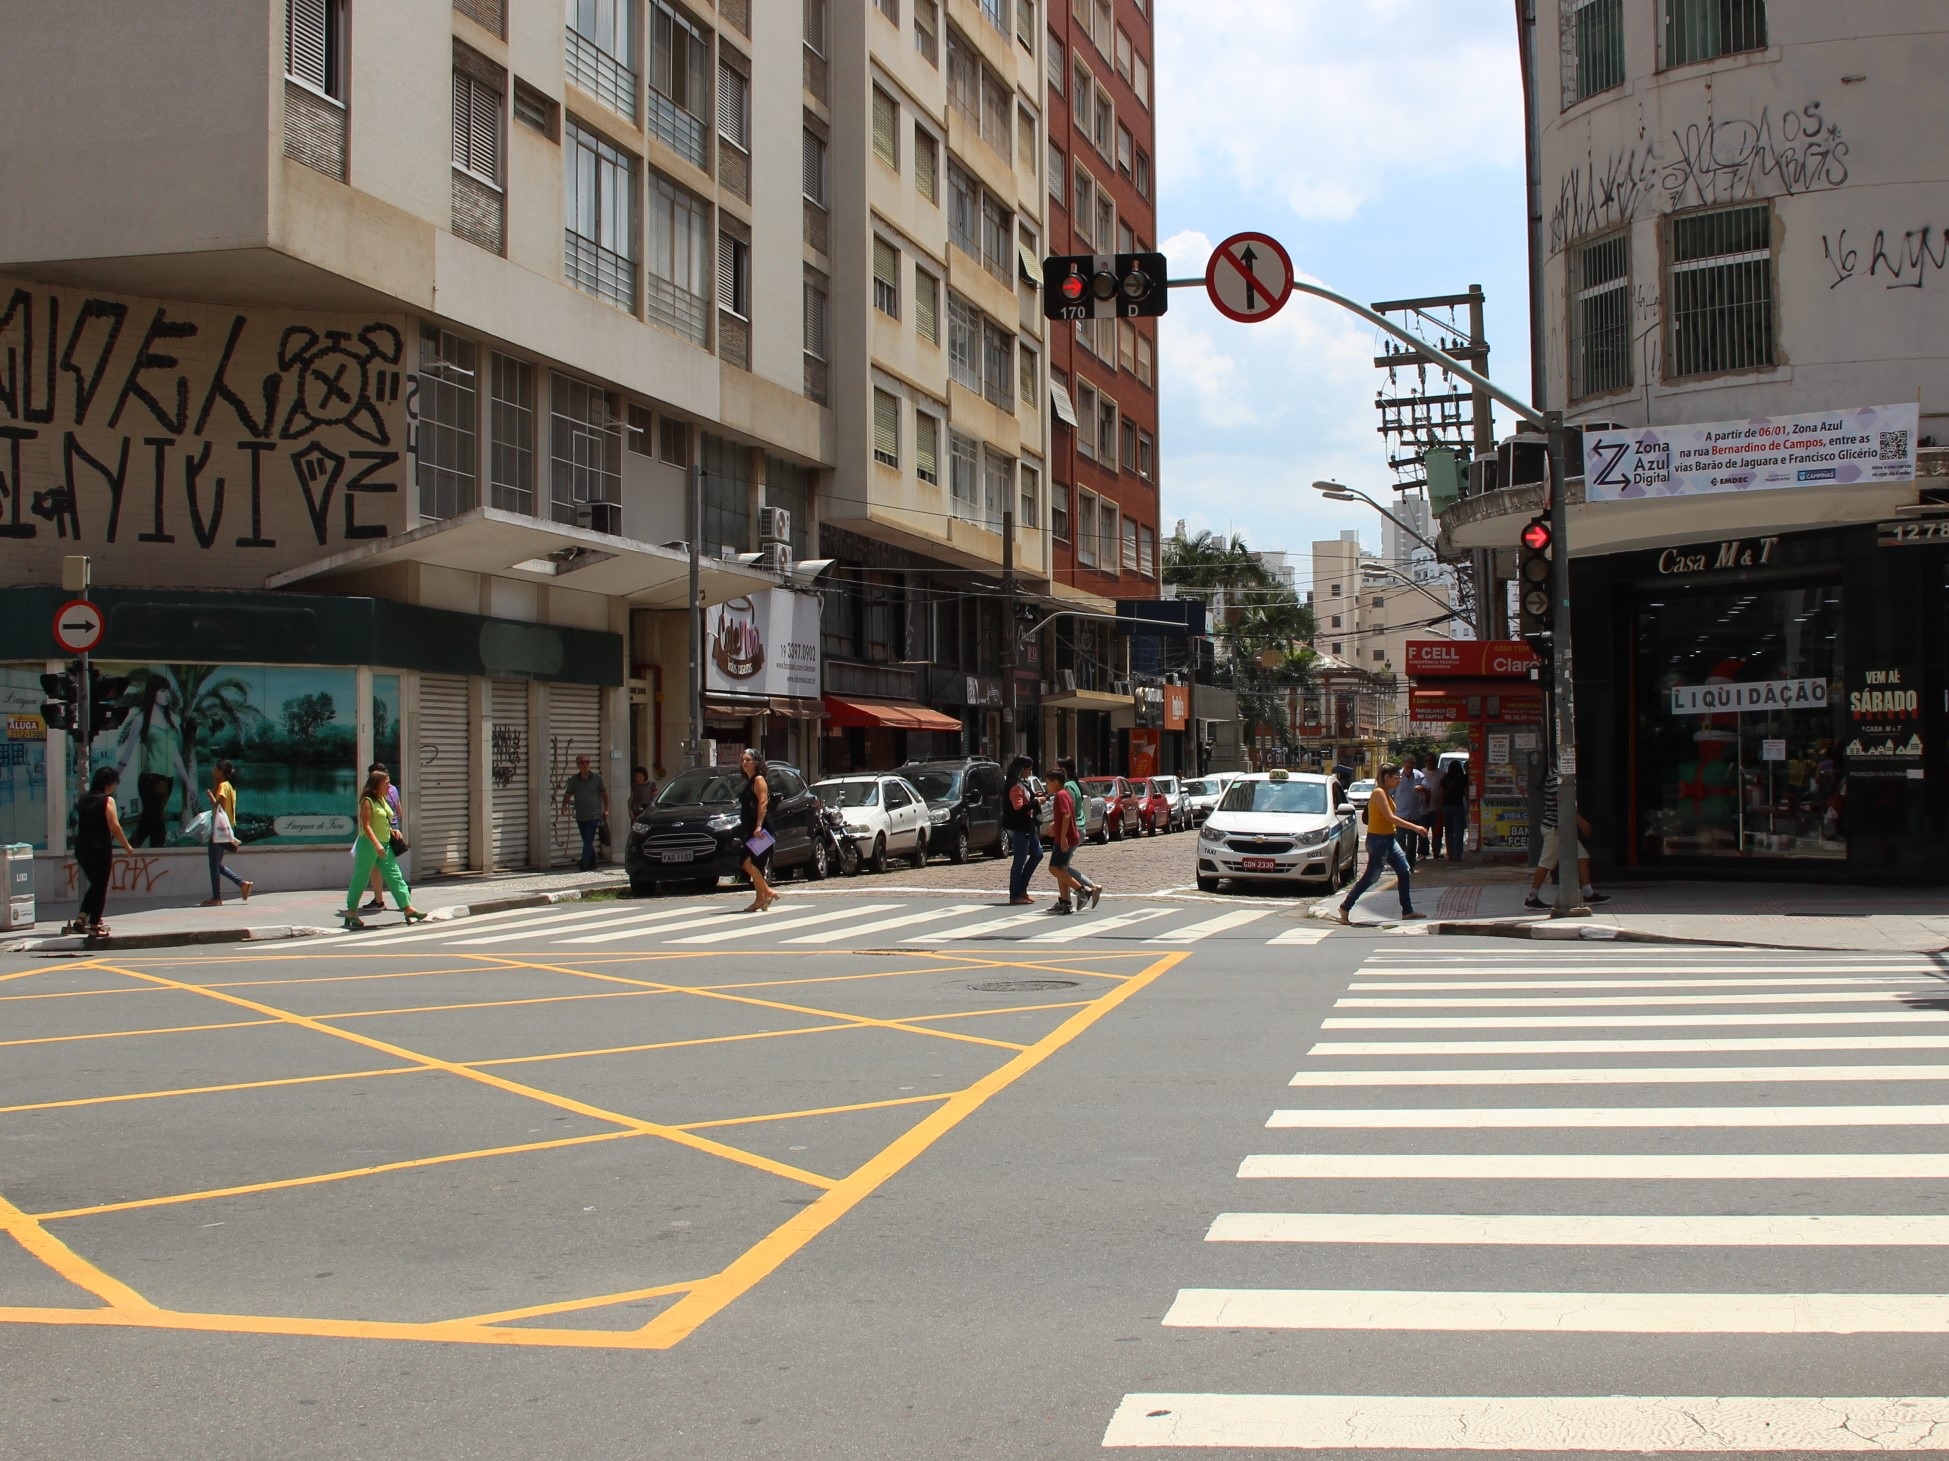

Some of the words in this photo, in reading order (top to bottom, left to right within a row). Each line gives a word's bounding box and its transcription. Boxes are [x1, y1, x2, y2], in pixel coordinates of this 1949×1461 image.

[1060, 306, 1086, 320] 170
[1128, 305, 1139, 317] D
[1705, 432, 1713, 442] A
[1714, 430, 1742, 443] partir
[1744, 428, 1757, 438] de
[1758, 425, 1790, 437] 06/01,
[1793, 424, 1818, 434] Zona
[1820, 420, 1843, 431] Azul
[1635, 440, 1670, 455] Zona
[1680, 449, 1692, 458] na
[1693, 448, 1710, 457] rua
[1711, 444, 1766, 456] Bernardino
[1768, 441, 1781, 451] de
[1783, 438, 1827, 451] Campos,
[1829, 437, 1857, 446] entre
[1858, 434, 1870, 443] as
[1633, 453, 1670, 472] Azul
[1674, 462, 1693, 473] vias
[1695, 459, 1723, 471] Barão
[1725, 458, 1738, 469] de
[1739, 455, 1778, 469] Jaguara
[1780, 456, 1787, 465] e
[1788, 452, 1836, 464] Francisco
[1838, 448, 1878, 460] Glicério
[1633, 470, 1670, 487] Digital
[1719, 476, 1748, 485] EMDEC
[1806, 472, 1834, 480] CAMPINAS
[1893, 521, 1949, 542] 1278
[1658, 549, 1706, 574] Casa
[1714, 541, 1740, 568] M
[1740, 549, 1753, 566] &
[1759, 537, 1779, 564] T
[1408, 647, 1417, 659] F
[1421, 647, 1460, 660] CELL
[1865, 670, 1886, 684] VEM
[1674, 681, 1826, 709] LIQUIDAÇÃO
[1850, 688, 1918, 712] SÁBADO
[9, 721, 37, 730] ALUGA
[1203, 847, 1217, 856] TAXI
[1306, 851, 1323, 859] 0071
[1257, 860, 1274, 869] 2330
[16, 873, 27, 882] LIXO
